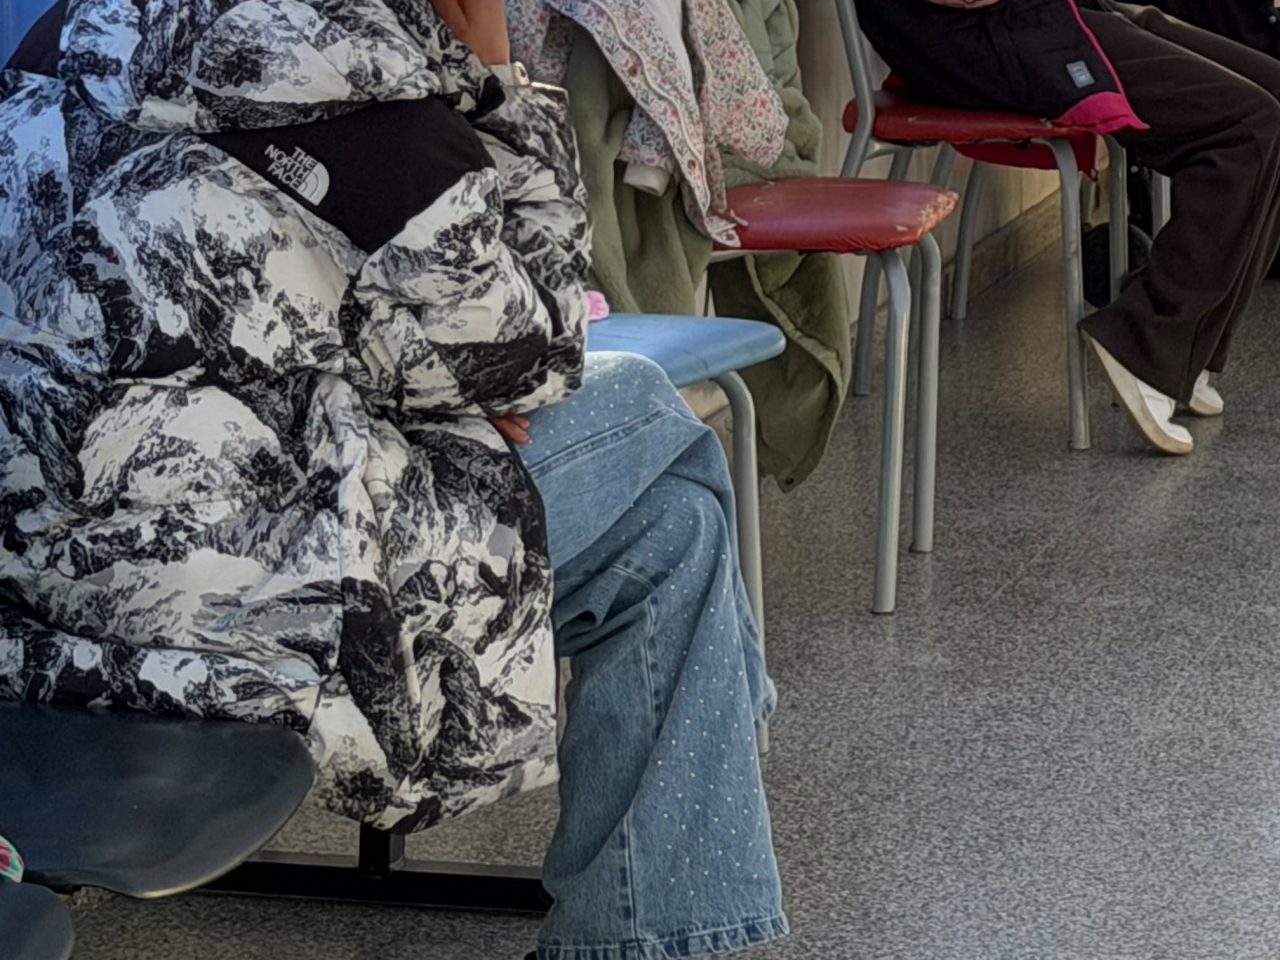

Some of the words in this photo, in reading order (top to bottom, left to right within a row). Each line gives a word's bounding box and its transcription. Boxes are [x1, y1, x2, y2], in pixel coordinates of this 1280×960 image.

[264, 144, 311, 182] NORTH
[292, 145, 319, 171] THE
[267, 161, 304, 190] FACE
